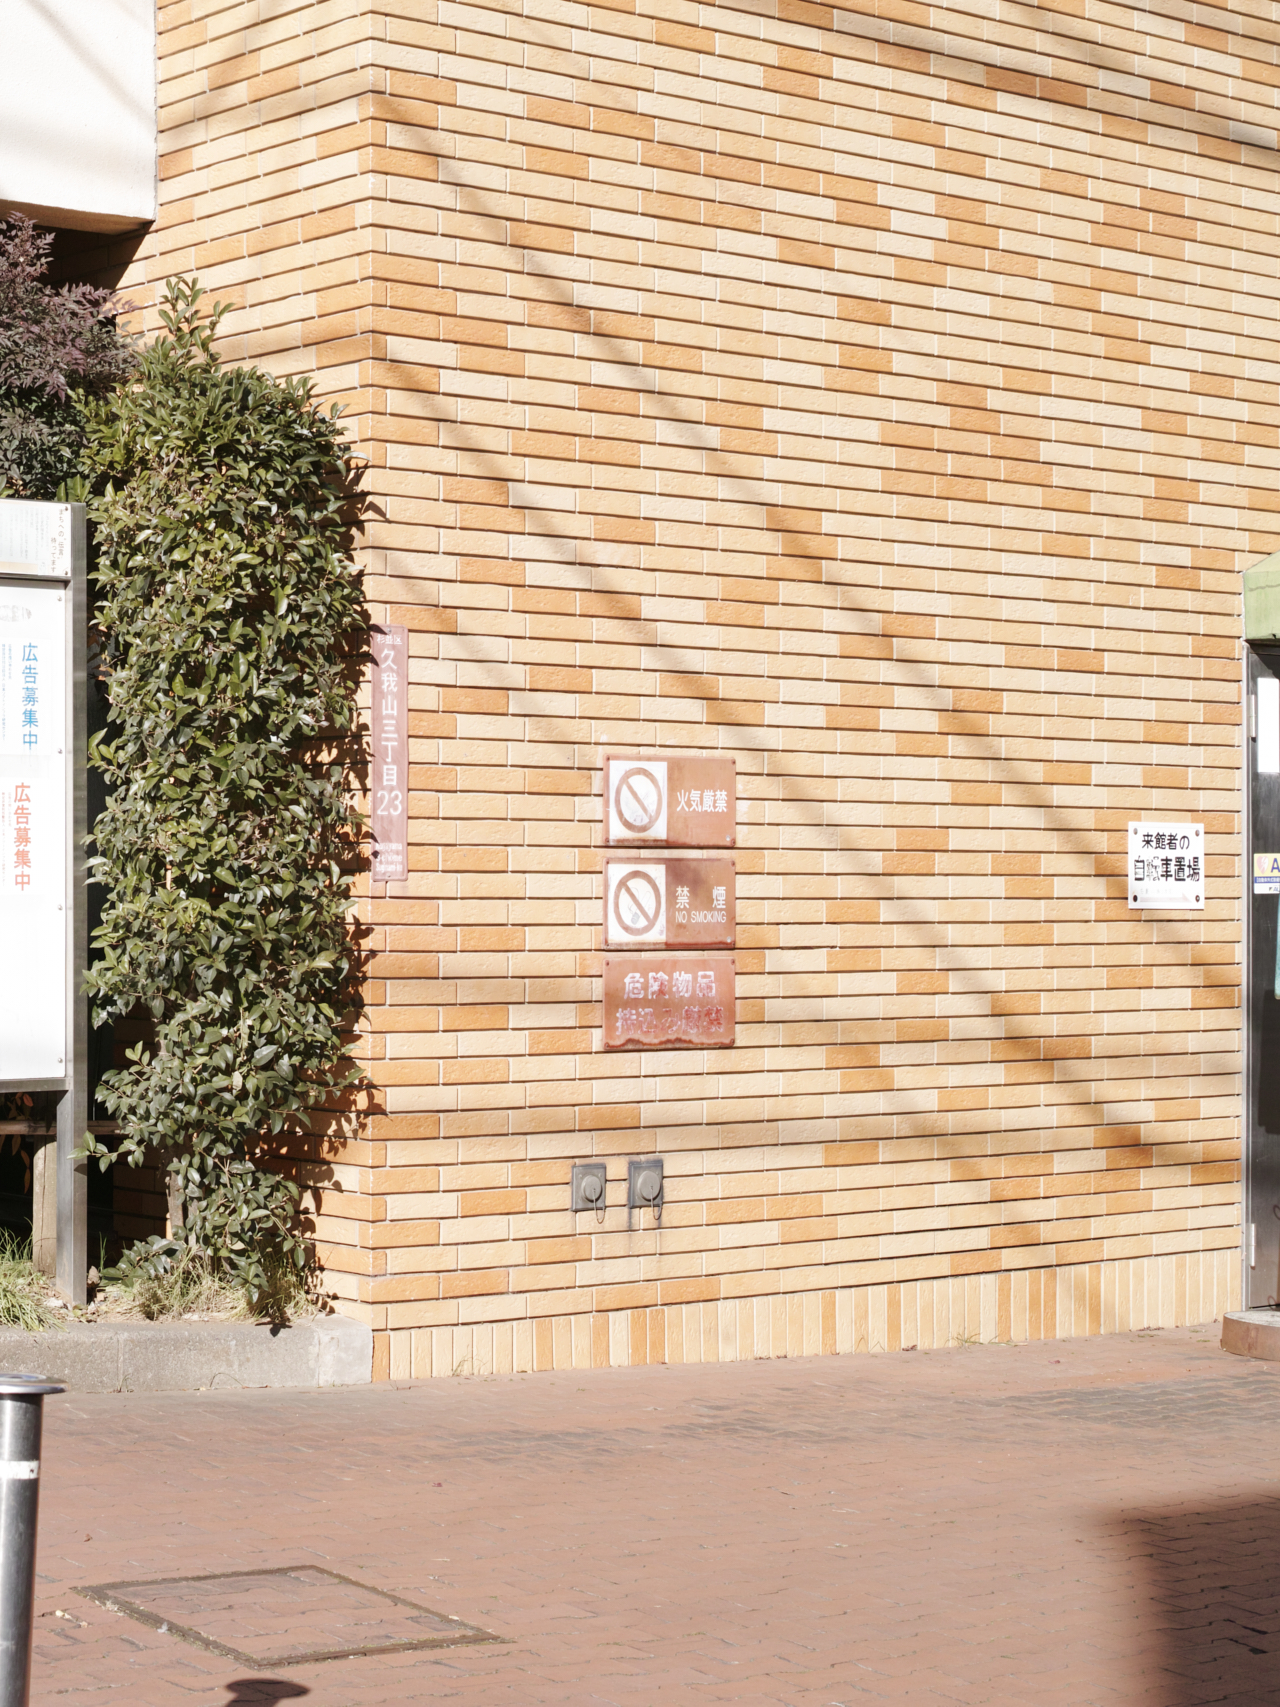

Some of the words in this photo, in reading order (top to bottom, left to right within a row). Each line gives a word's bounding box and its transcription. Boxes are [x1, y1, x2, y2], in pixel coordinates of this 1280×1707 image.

[376, 633, 403, 645] 杉並区
[21, 642, 39, 751] 広告募集中
[379, 648, 399, 787] 久我山三丁目
[376, 789, 403, 816] 23
[675, 788, 728, 813] 火気厳禁
[13, 782, 32, 892] 広告募集中
[1141, 831, 1191, 851] 来館者の
[675, 885, 726, 910] 禁煙
[675, 911, 688, 923] NO
[690, 911, 727, 924] SMOKING
[622, 970, 717, 1000] 危険物品
